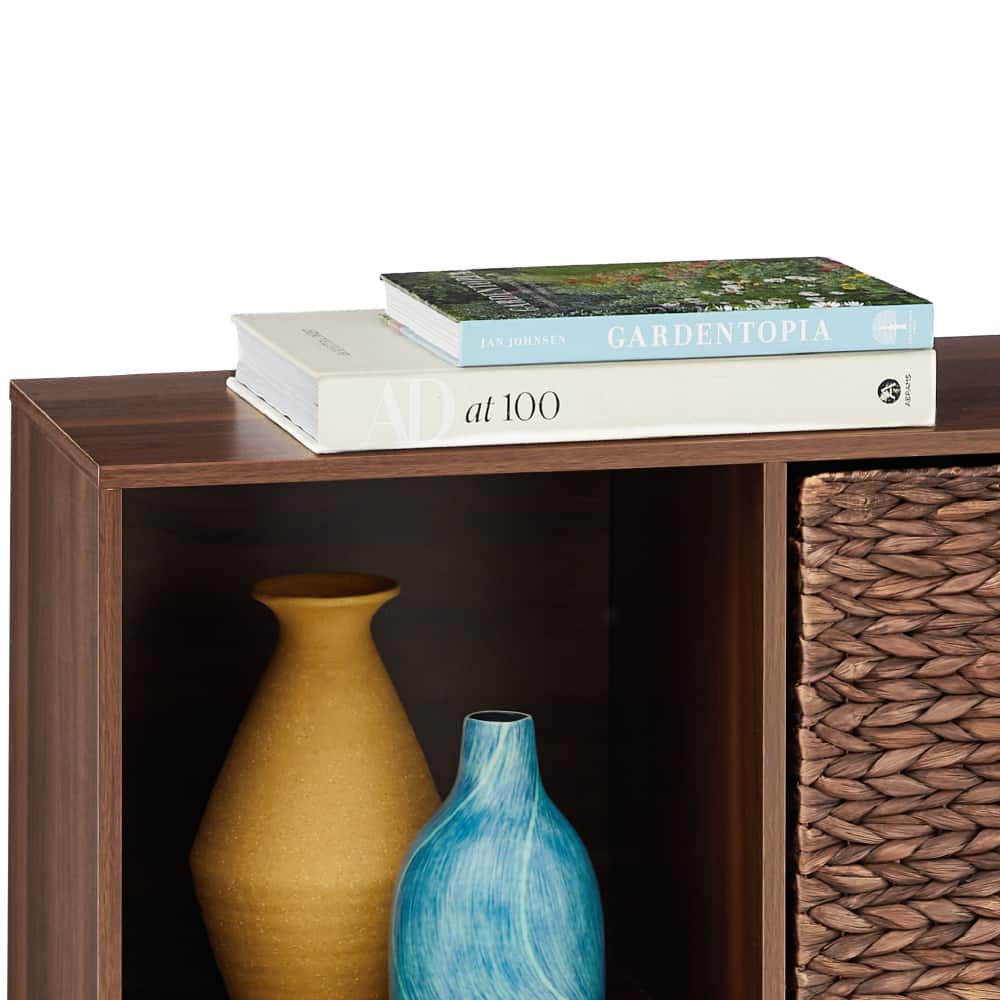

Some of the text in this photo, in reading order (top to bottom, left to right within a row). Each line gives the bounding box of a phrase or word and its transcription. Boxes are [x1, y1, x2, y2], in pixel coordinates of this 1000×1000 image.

[480, 335, 567, 349] JAN JOHNSEN
[607, 319, 832, 349] GARDENTOPIA
[366, 378, 561, 443] AD at 100
